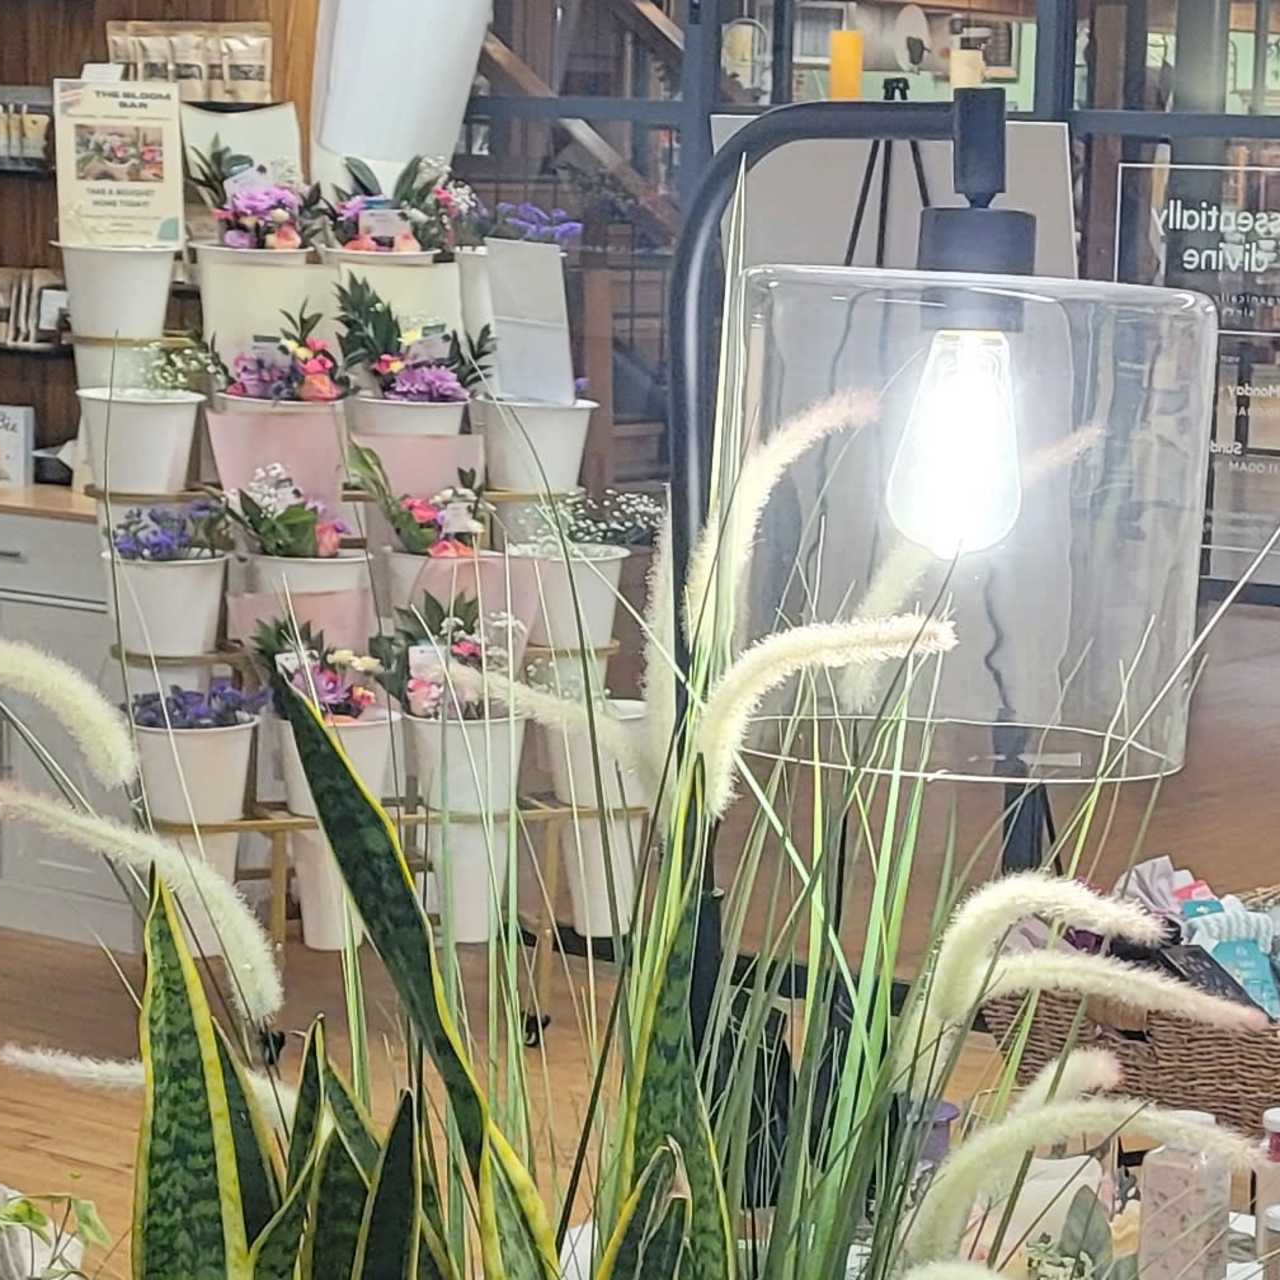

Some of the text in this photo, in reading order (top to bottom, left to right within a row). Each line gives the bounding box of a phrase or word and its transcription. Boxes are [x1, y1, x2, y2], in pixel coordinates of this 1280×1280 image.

[94, 90, 172, 101] THE BLOOM
[118, 101, 148, 110] BAR
